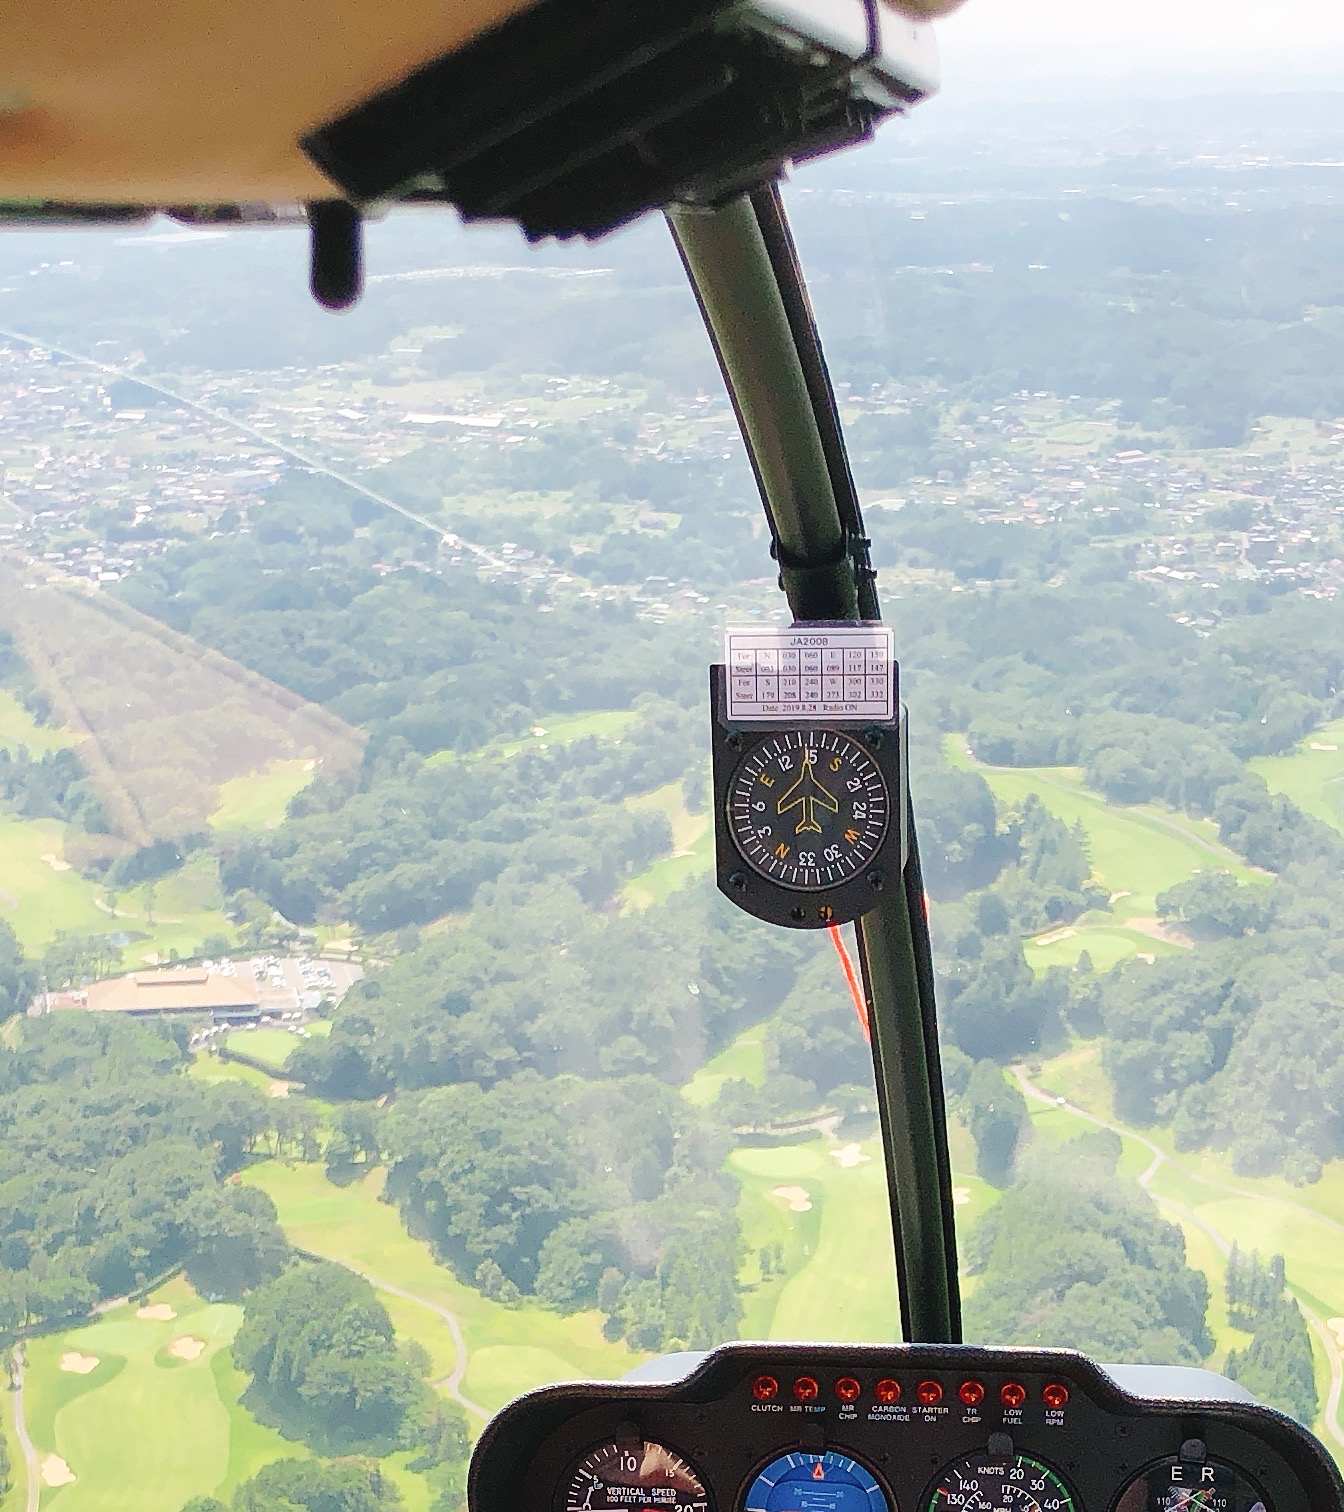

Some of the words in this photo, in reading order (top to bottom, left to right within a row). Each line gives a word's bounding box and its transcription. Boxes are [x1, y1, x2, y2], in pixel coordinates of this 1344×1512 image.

[807, 749, 818, 764] 15
[778, 756, 793, 771] 12
[829, 758, 842, 771] S
[759, 773, 774, 788] E
[846, 777, 863, 793] 21
[752, 801, 766, 812] 6
[853, 802, 867, 820] 24
[757, 826, 772, 839] 3
[844, 829, 860, 845] W
[775, 843, 790, 859] N
[824, 844, 842, 861] 30
[799, 851, 816, 866] 33
[868, 1414, 910, 1422] MONOXIDE
[620, 1457, 637, 1471] 10
[978, 1467, 1004, 1475] KNOTS
[1010, 1469, 1024, 1479] 20
[1171, 1466, 1183, 1481] E
[1202, 1467, 1215, 1481] R
[607, 1487, 645, 1496] VERTICAL
[652, 1488, 676, 1496] SPEED
[960, 1480, 978, 1490] 140
[1030, 1480, 1044, 1490] 30
[947, 1494, 965, 1505] 130
[1003, 1495, 1013, 1503] 20
[1044, 1499, 1059, 1510] 40
[1157, 1497, 1170, 1505] 110
[1213, 1499, 1226, 1507] 110
